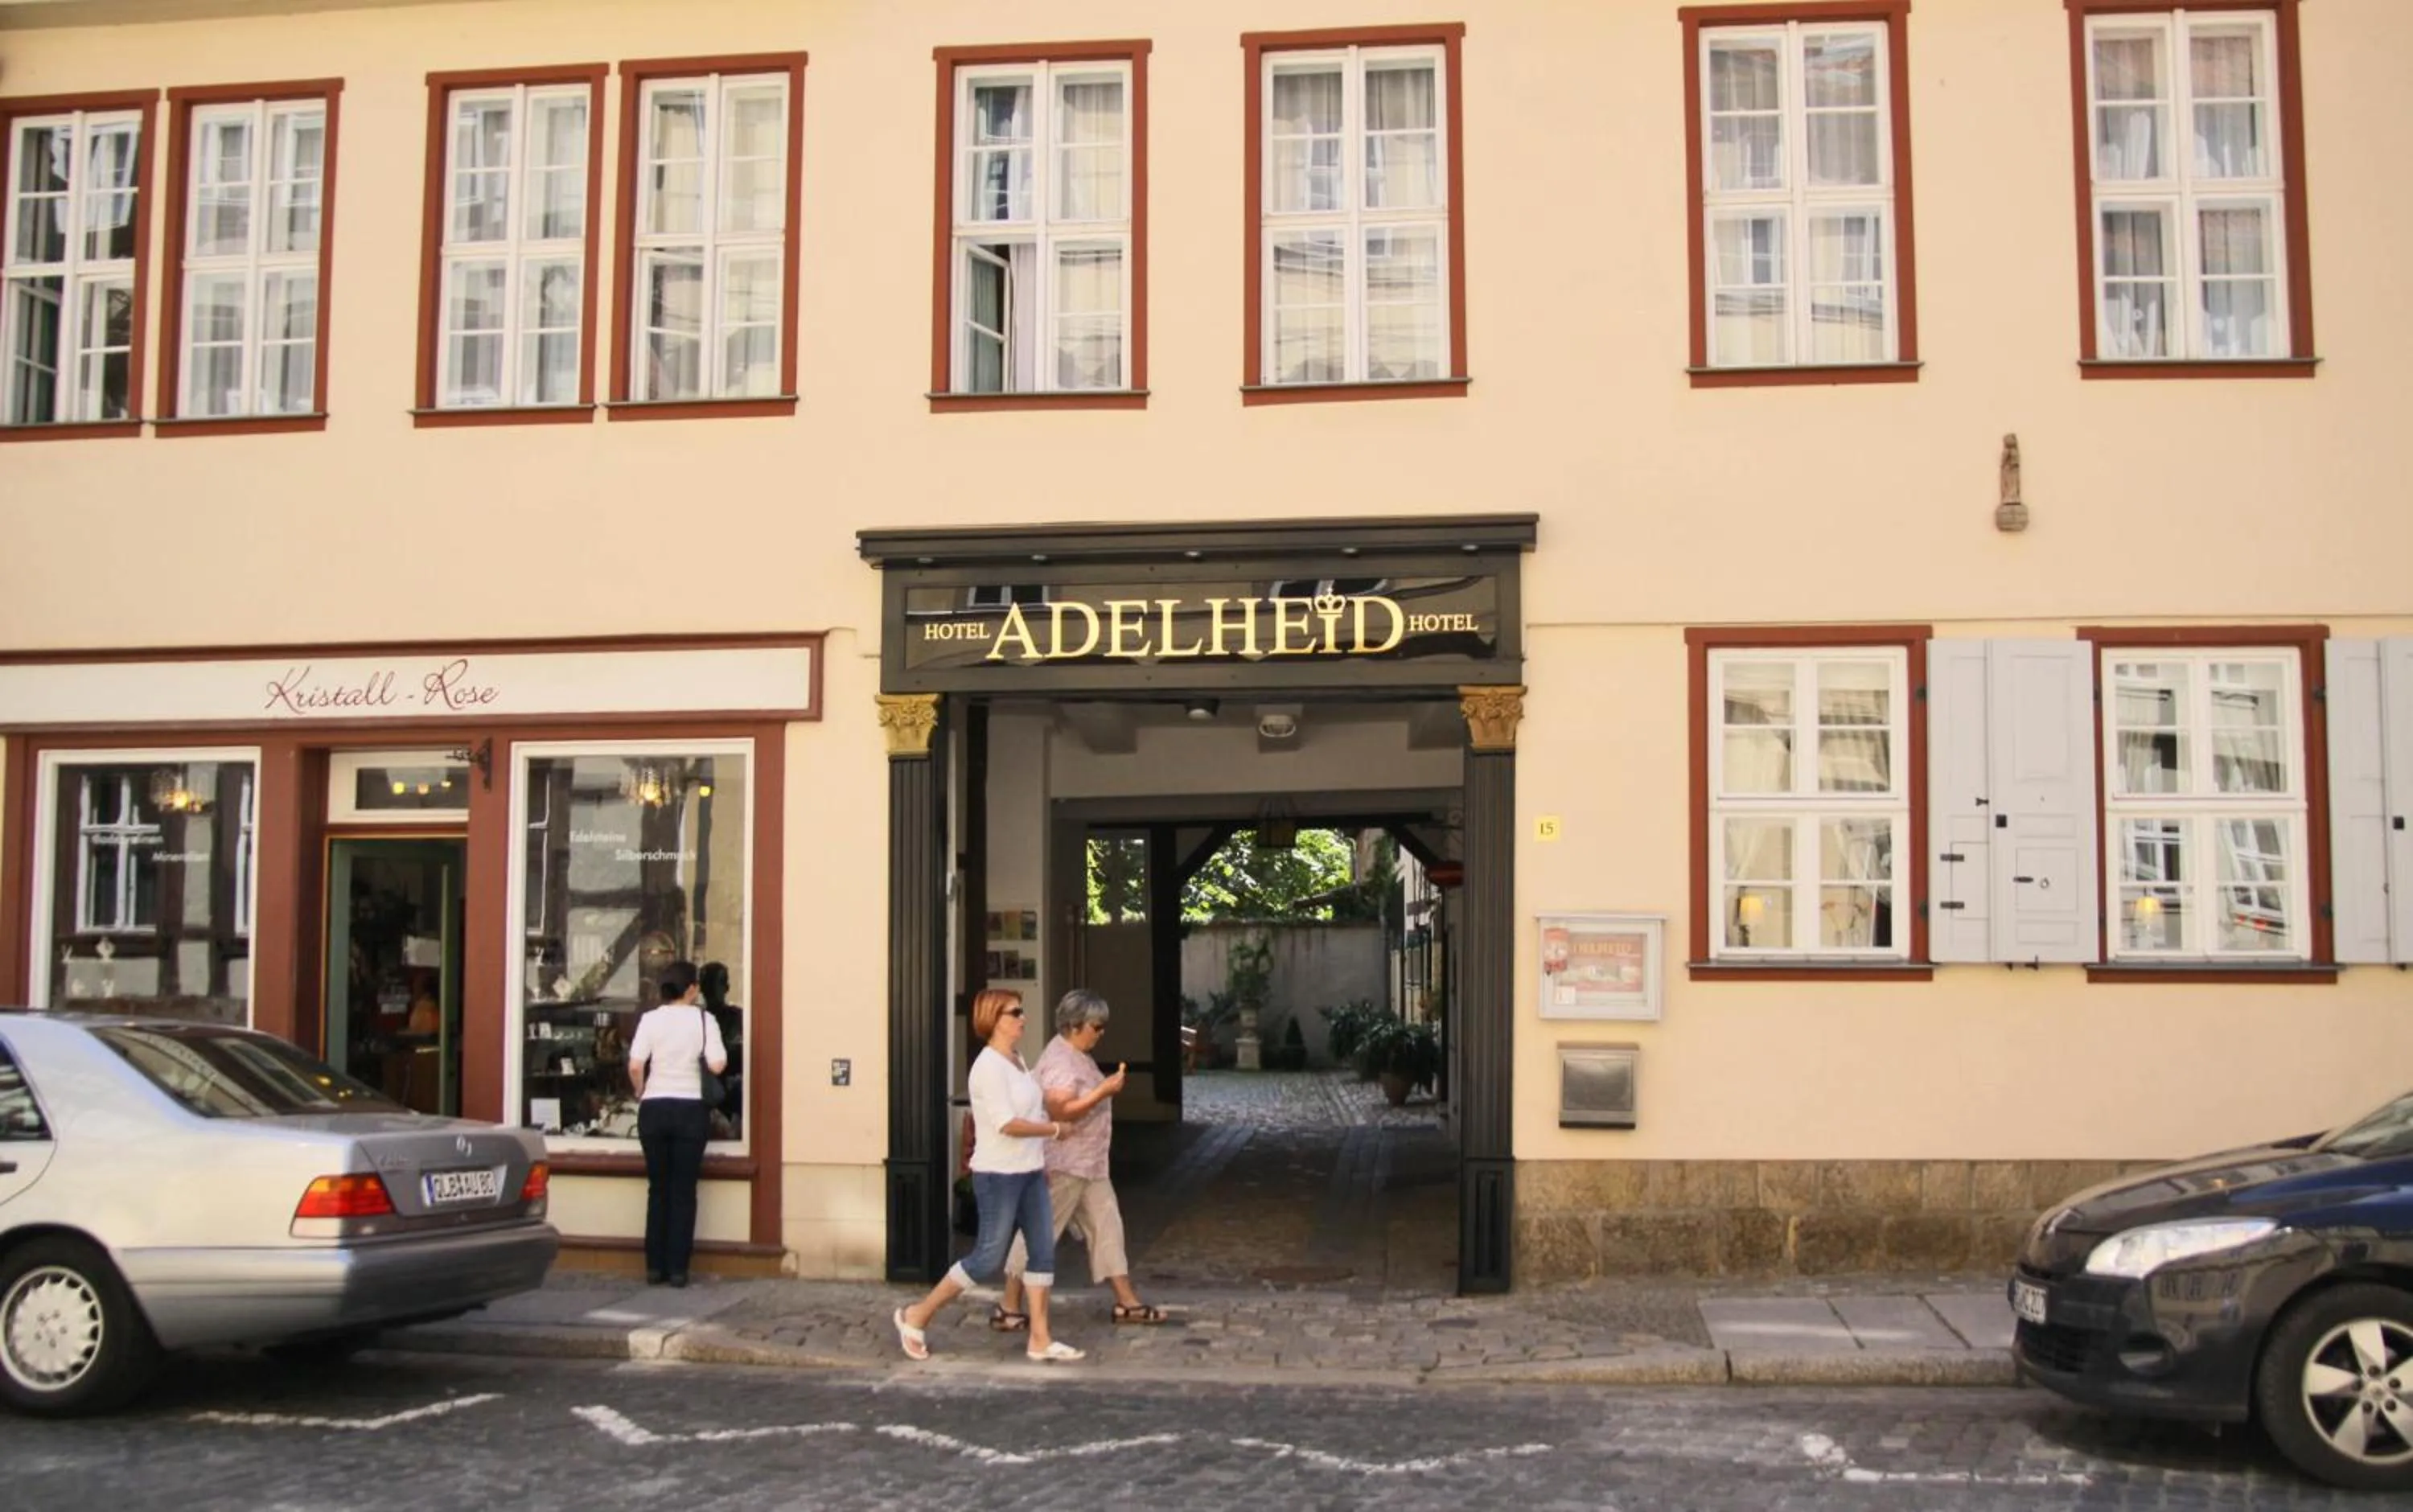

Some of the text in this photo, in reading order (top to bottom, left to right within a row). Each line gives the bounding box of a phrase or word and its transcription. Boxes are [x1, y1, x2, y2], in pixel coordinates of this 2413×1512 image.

[924, 591, 1479, 660] HOTEL ADELHEID HOTEL
[265, 665, 397, 714] Kristall
[424, 658, 500, 711] Rose
[1539, 822, 1554, 835] 15
